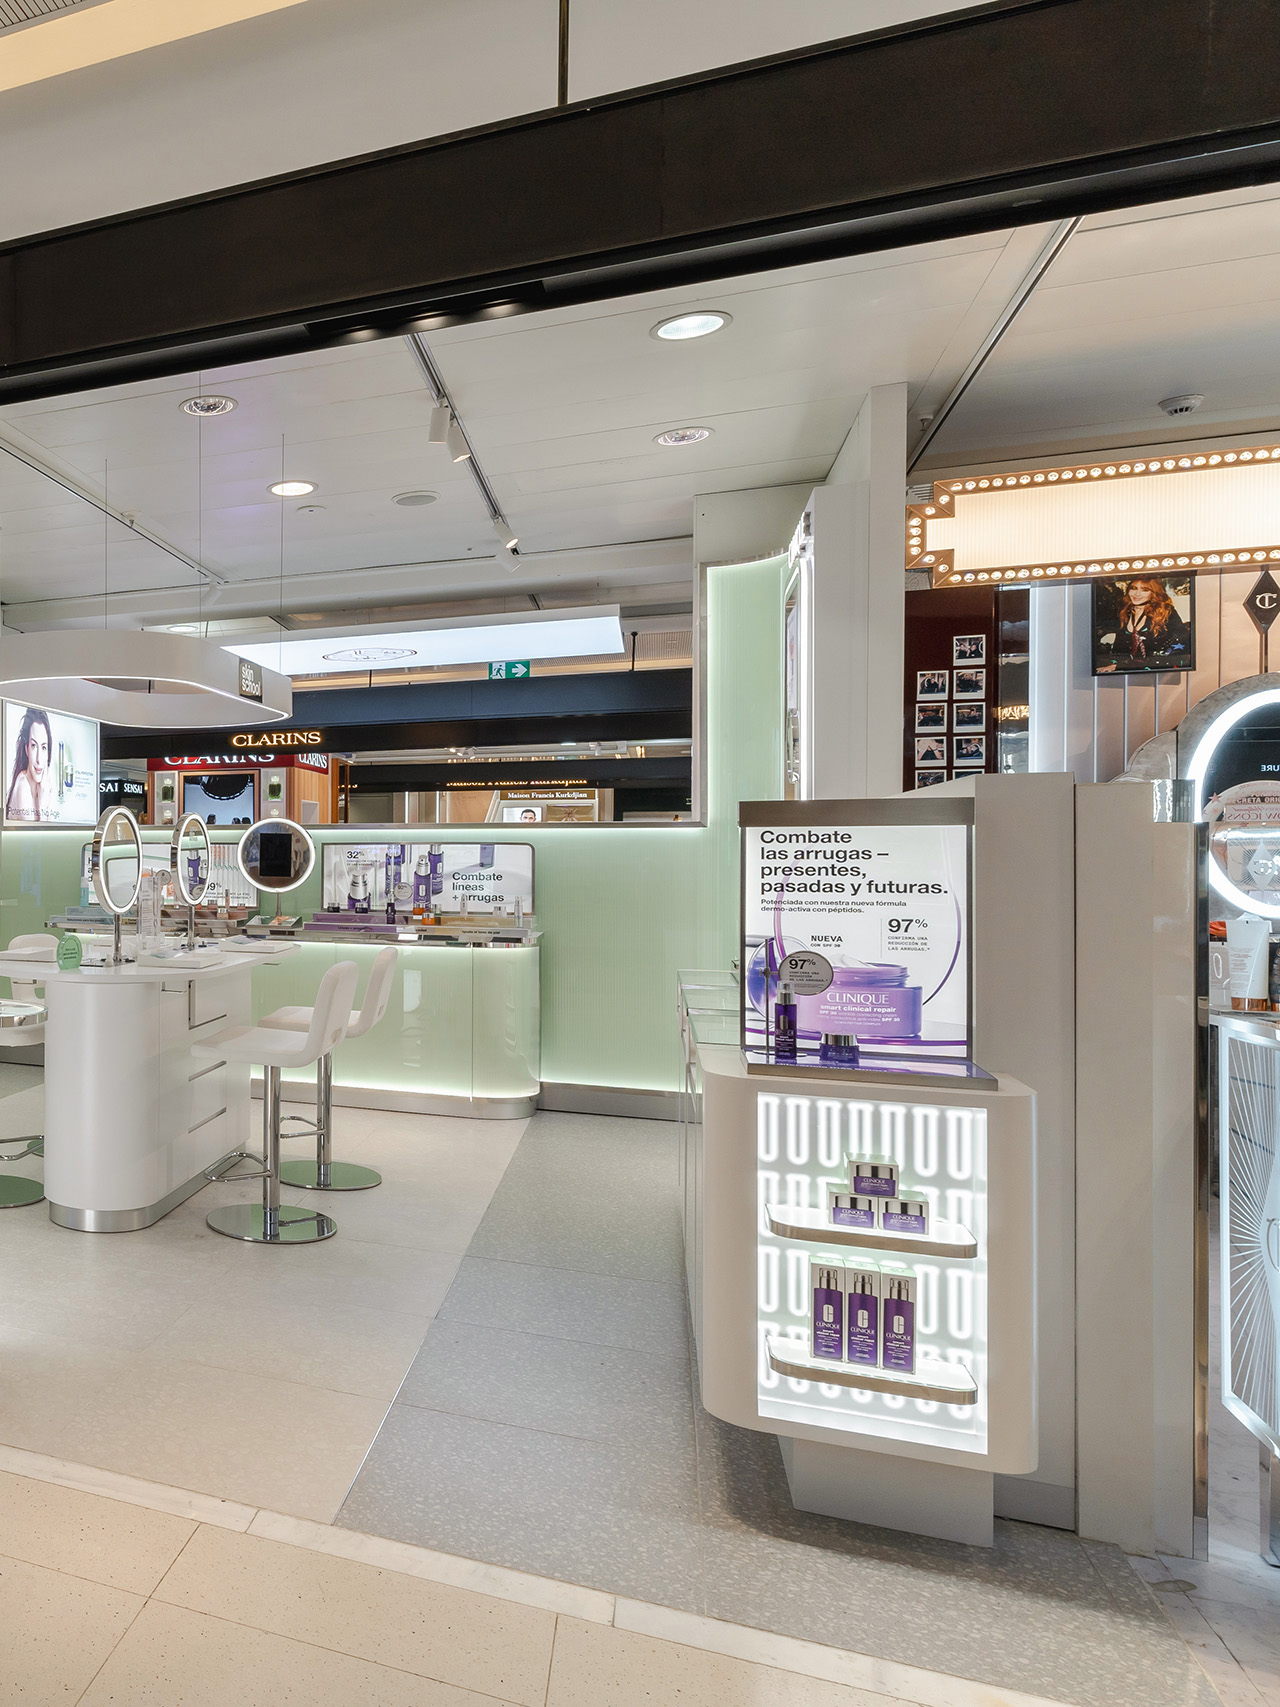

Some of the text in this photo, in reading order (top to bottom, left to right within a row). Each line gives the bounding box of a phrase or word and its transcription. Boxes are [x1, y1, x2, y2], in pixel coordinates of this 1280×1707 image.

[241, 664, 254, 680] skin
[242, 679, 261, 696] school
[232, 731, 321, 747] CLARINS
[298, 753, 328, 769] CLARINS
[124, 783, 142, 793] SENSAI
[8, 807, 29, 816] Potential
[31, 808, 40, 816] Has
[50, 809, 60, 819] Age
[760, 830, 852, 844] Combate
[761, 847, 788, 860] las
[794, 850, 872, 863] arrugas
[452, 872, 503, 881] Combate
[761, 864, 867, 880] presentes,
[452, 882, 484, 891] líneas
[761, 880, 948, 896] pasadas y futuras.
[888, 918, 928, 933] 97%
[789, 959, 816, 970] 97%
[827, 992, 889, 1005] CLINIQUE
